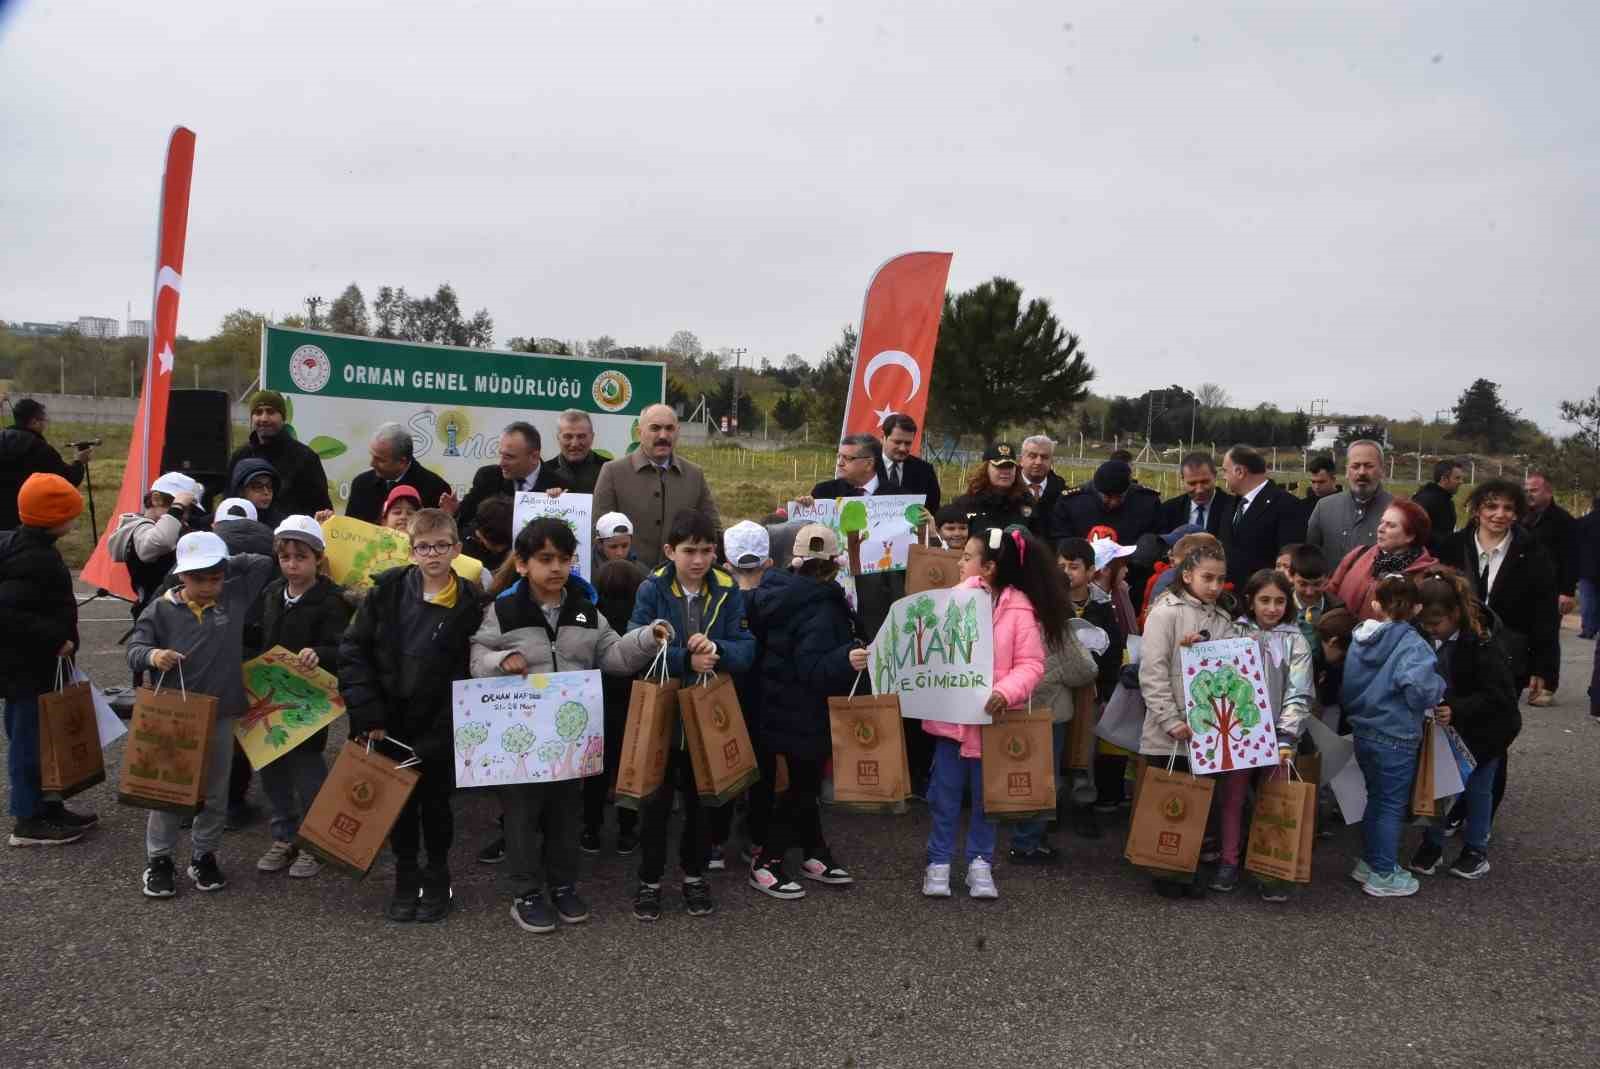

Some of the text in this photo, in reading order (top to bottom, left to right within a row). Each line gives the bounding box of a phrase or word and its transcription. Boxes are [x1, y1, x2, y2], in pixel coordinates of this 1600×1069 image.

[343, 364, 581, 399] ORMAN GENEL MÜDÜRLÜĞÜ
[860, 763, 877, 776] 112
[1011, 775, 1028, 786] 112
